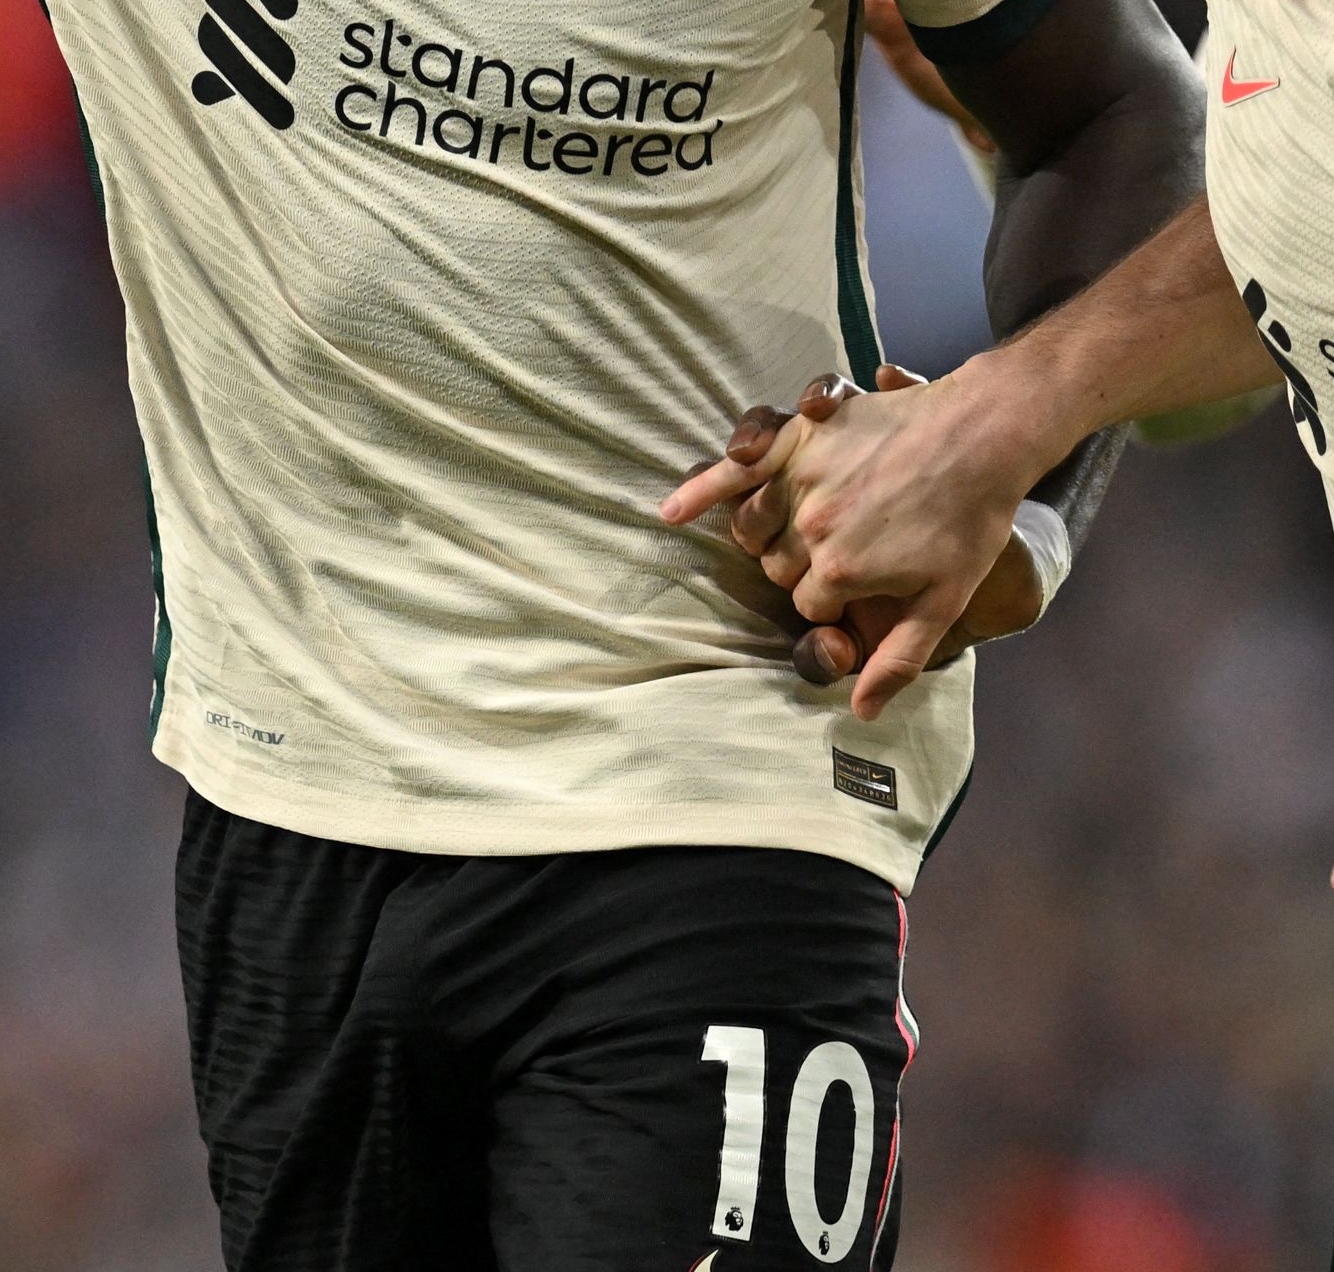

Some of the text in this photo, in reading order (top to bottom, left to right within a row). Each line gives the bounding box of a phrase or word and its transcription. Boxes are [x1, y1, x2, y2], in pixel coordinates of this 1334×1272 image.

[338, 18, 715, 124] standard
[334, 80, 723, 176] chartered
[701, 1025, 875, 1264] 10
